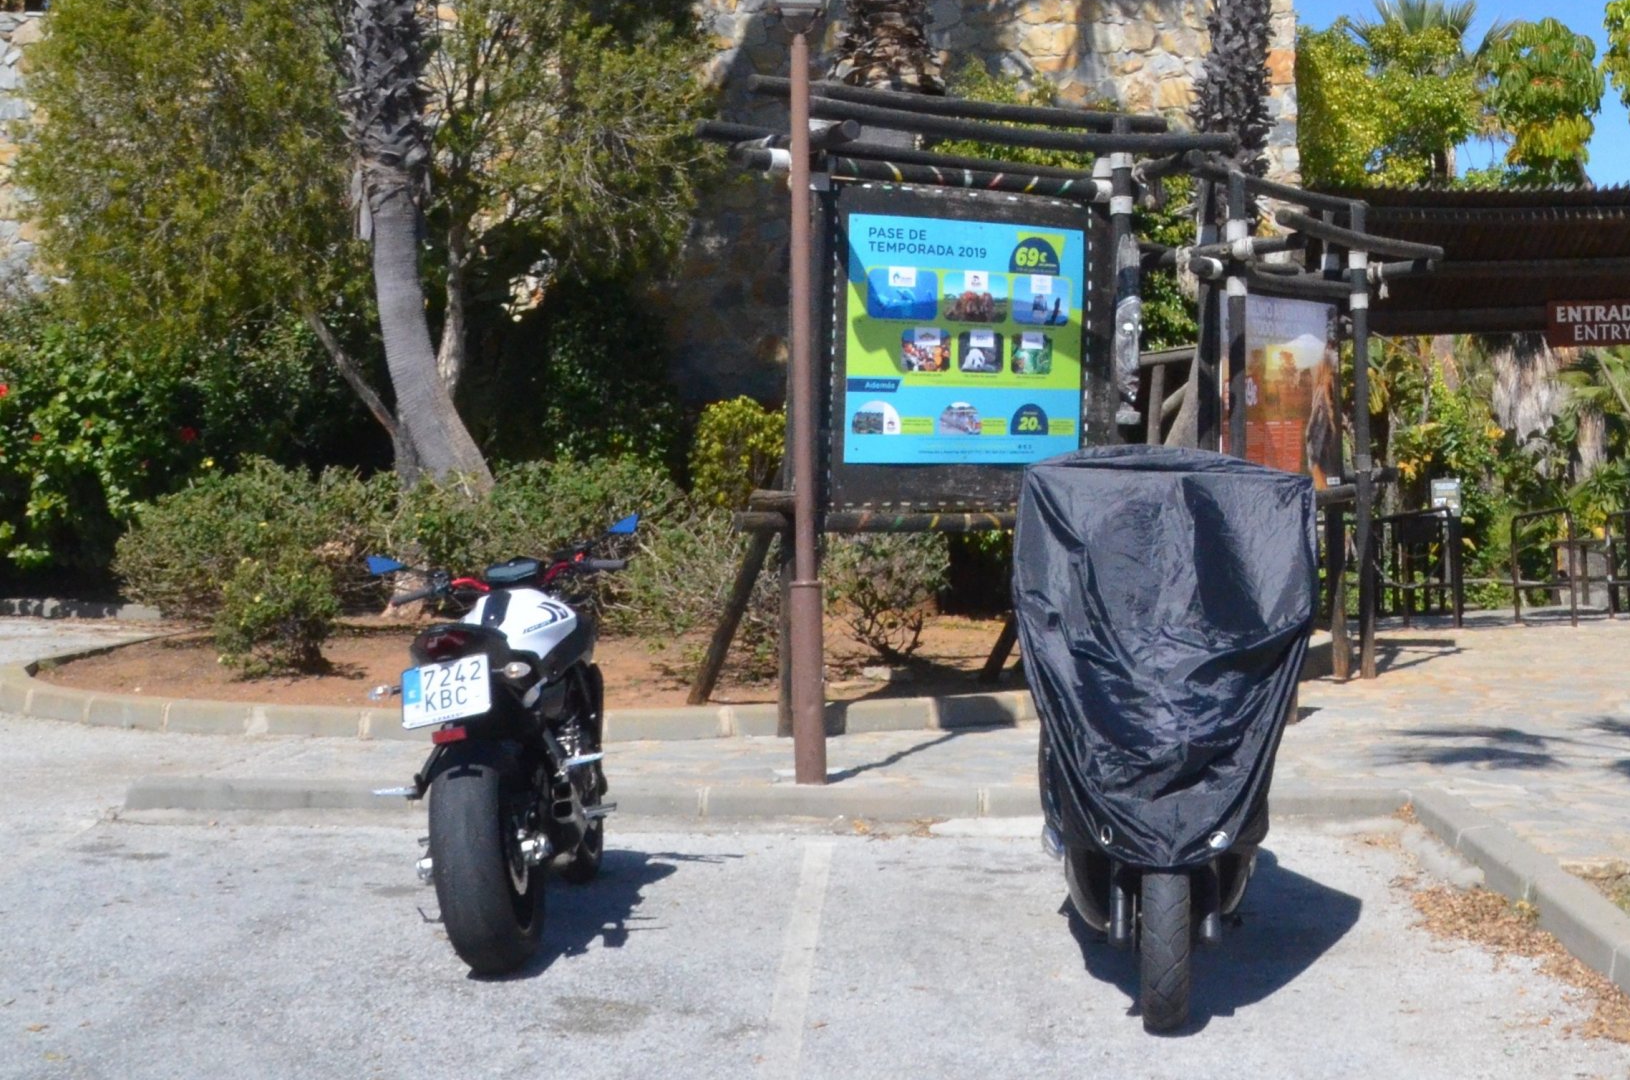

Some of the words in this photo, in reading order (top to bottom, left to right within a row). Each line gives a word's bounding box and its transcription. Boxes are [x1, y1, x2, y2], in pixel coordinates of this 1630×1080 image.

[868, 226, 904, 241] PASE
[909, 229, 927, 241] DE
[868, 241, 954, 257] TEMPORADA
[958, 246, 987, 259] 2019
[423, 660, 482, 691] 7242
[425, 686, 468, 713] KBC
